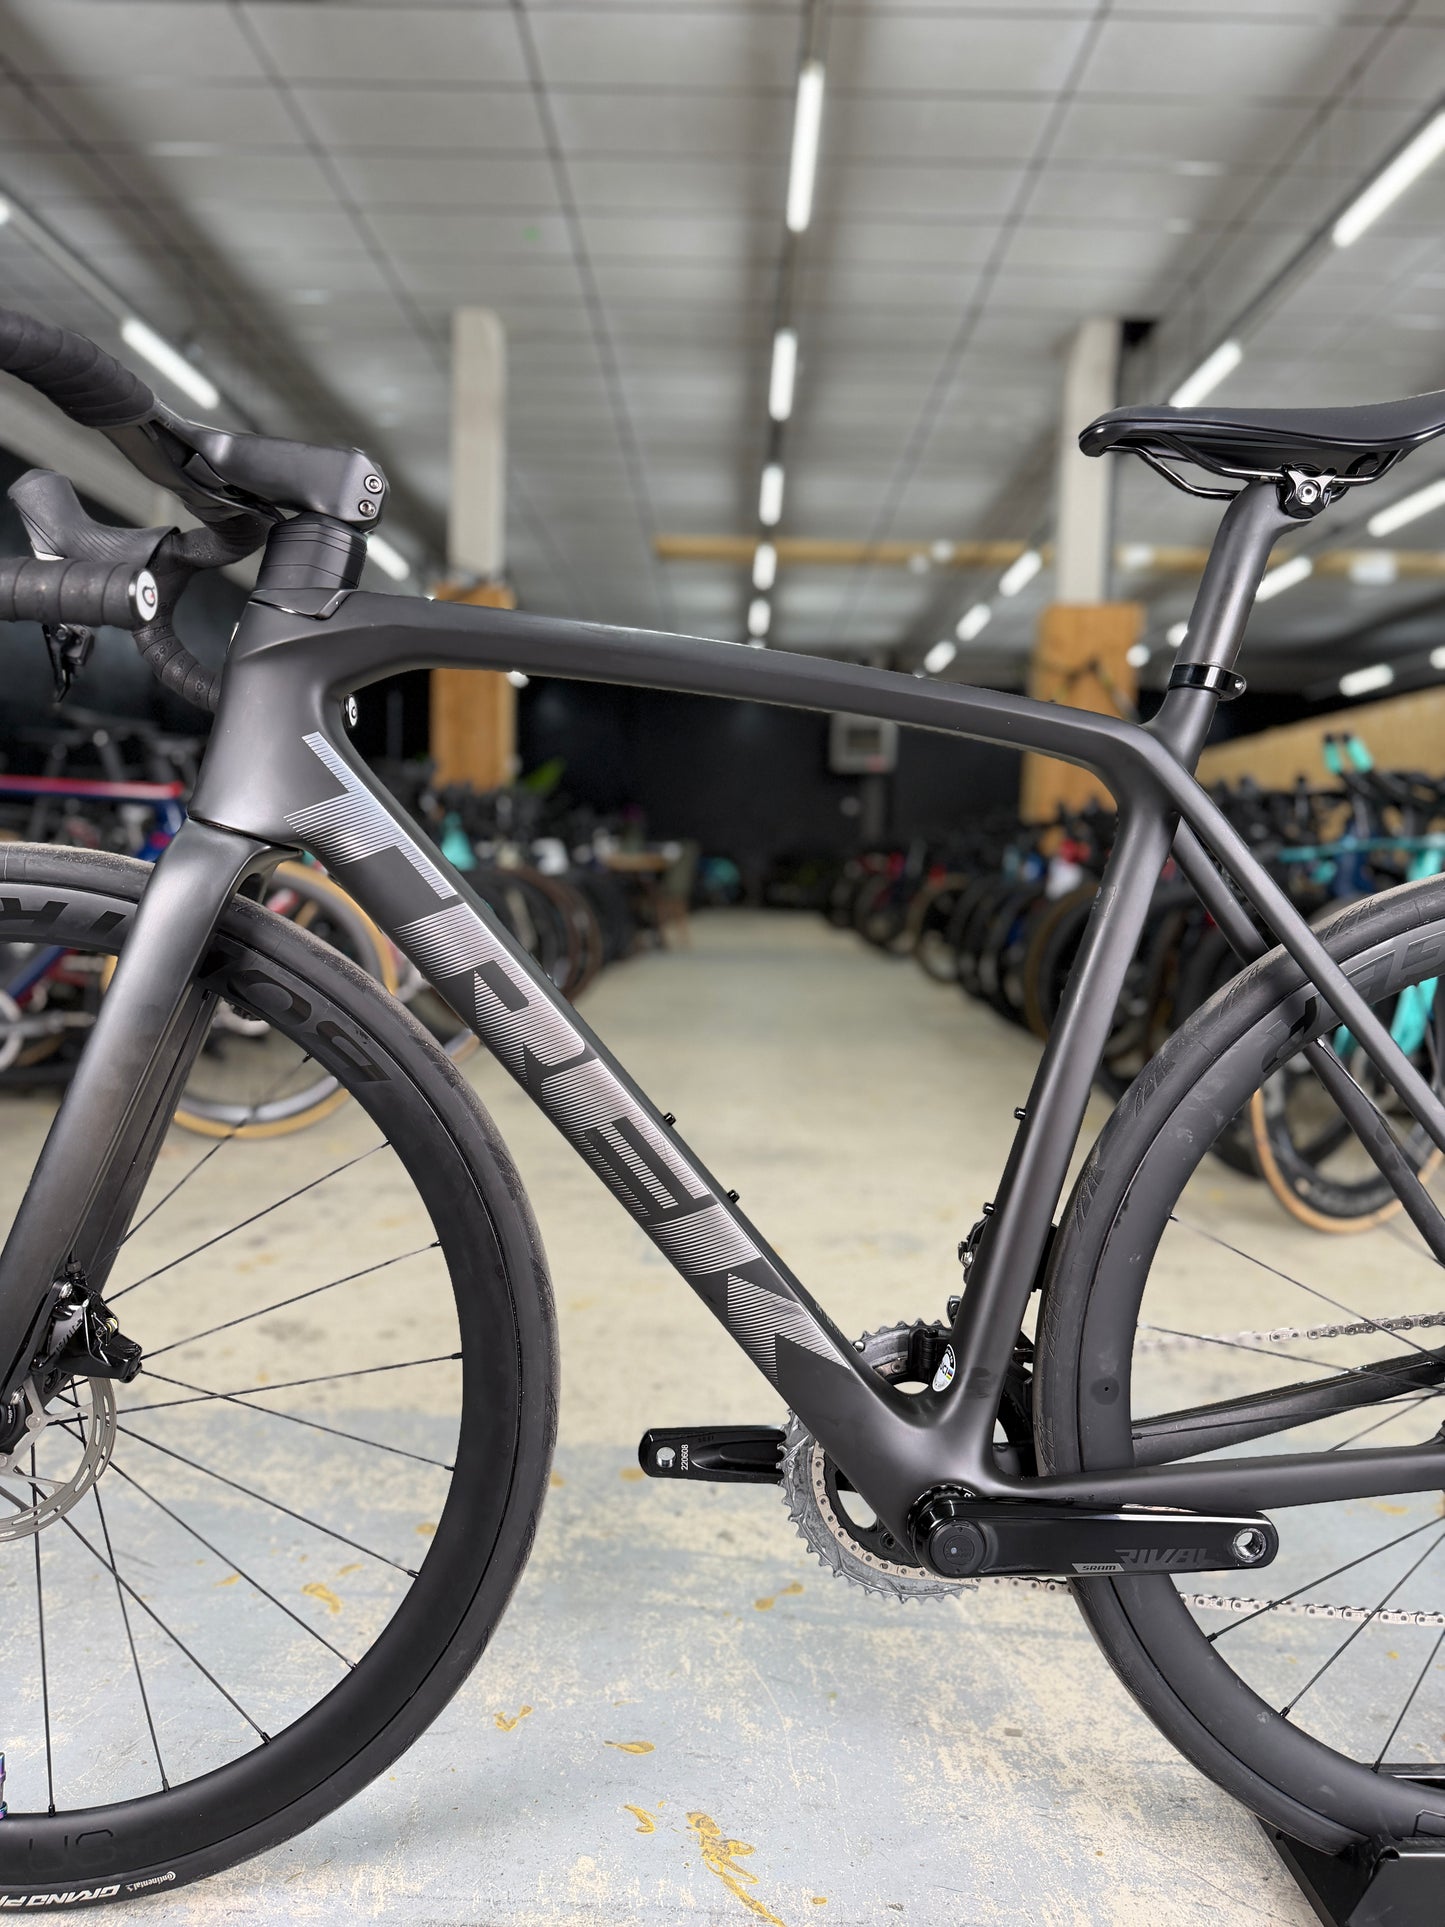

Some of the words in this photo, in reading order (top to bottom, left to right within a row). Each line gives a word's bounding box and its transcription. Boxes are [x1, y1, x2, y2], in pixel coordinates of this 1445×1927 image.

[283, 731, 851, 1386] TREK
[680, 1444, 689, 1471] 220608
[1114, 1548, 1217, 1566] RIVAL
[134, 1871, 177, 1890] Continental
[27, 1884, 121, 1906] GRAND
